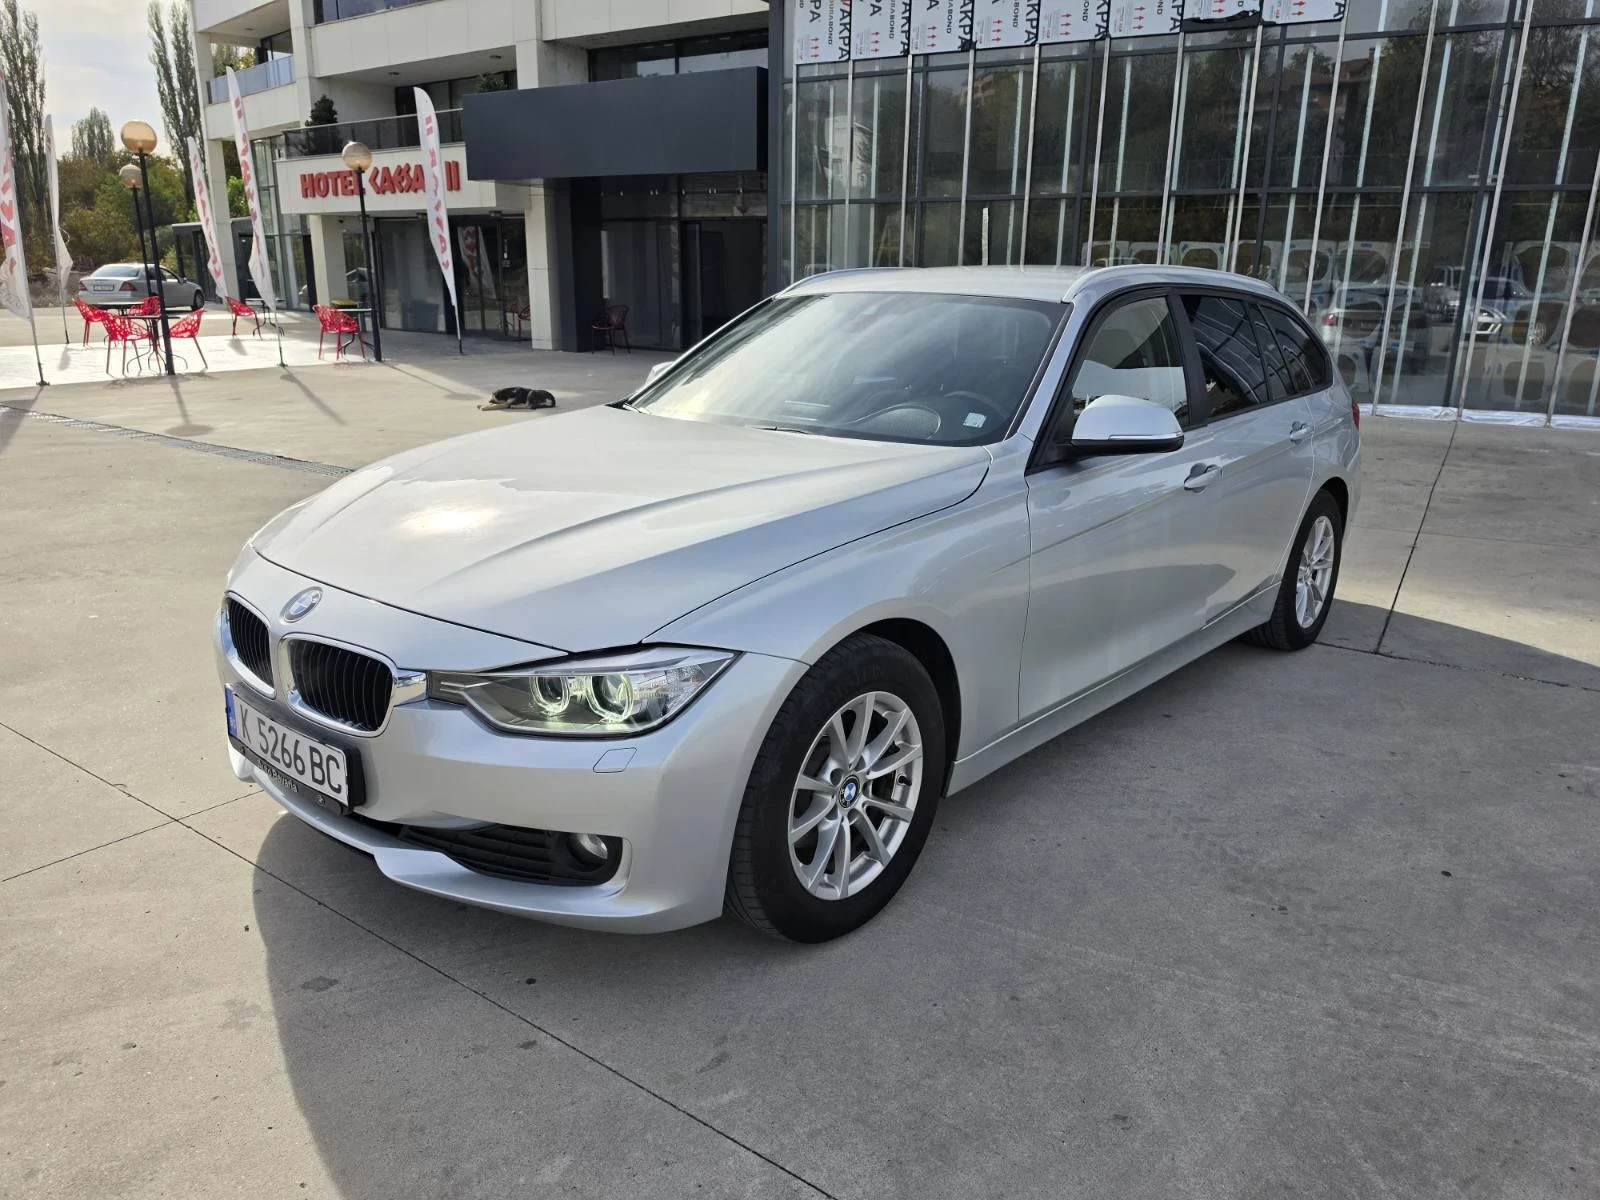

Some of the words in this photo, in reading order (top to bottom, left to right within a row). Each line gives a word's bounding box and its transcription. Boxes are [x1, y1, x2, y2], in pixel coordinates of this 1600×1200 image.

[1024, 0, 1038, 43] KPA
[300, 170, 366, 199] HOTEL
[368, 163, 426, 195] CAESA
[445, 161, 461, 191] II
[240, 704, 251, 744] K
[257, 717, 305, 776] 5266
[309, 746, 342, 794] BC
